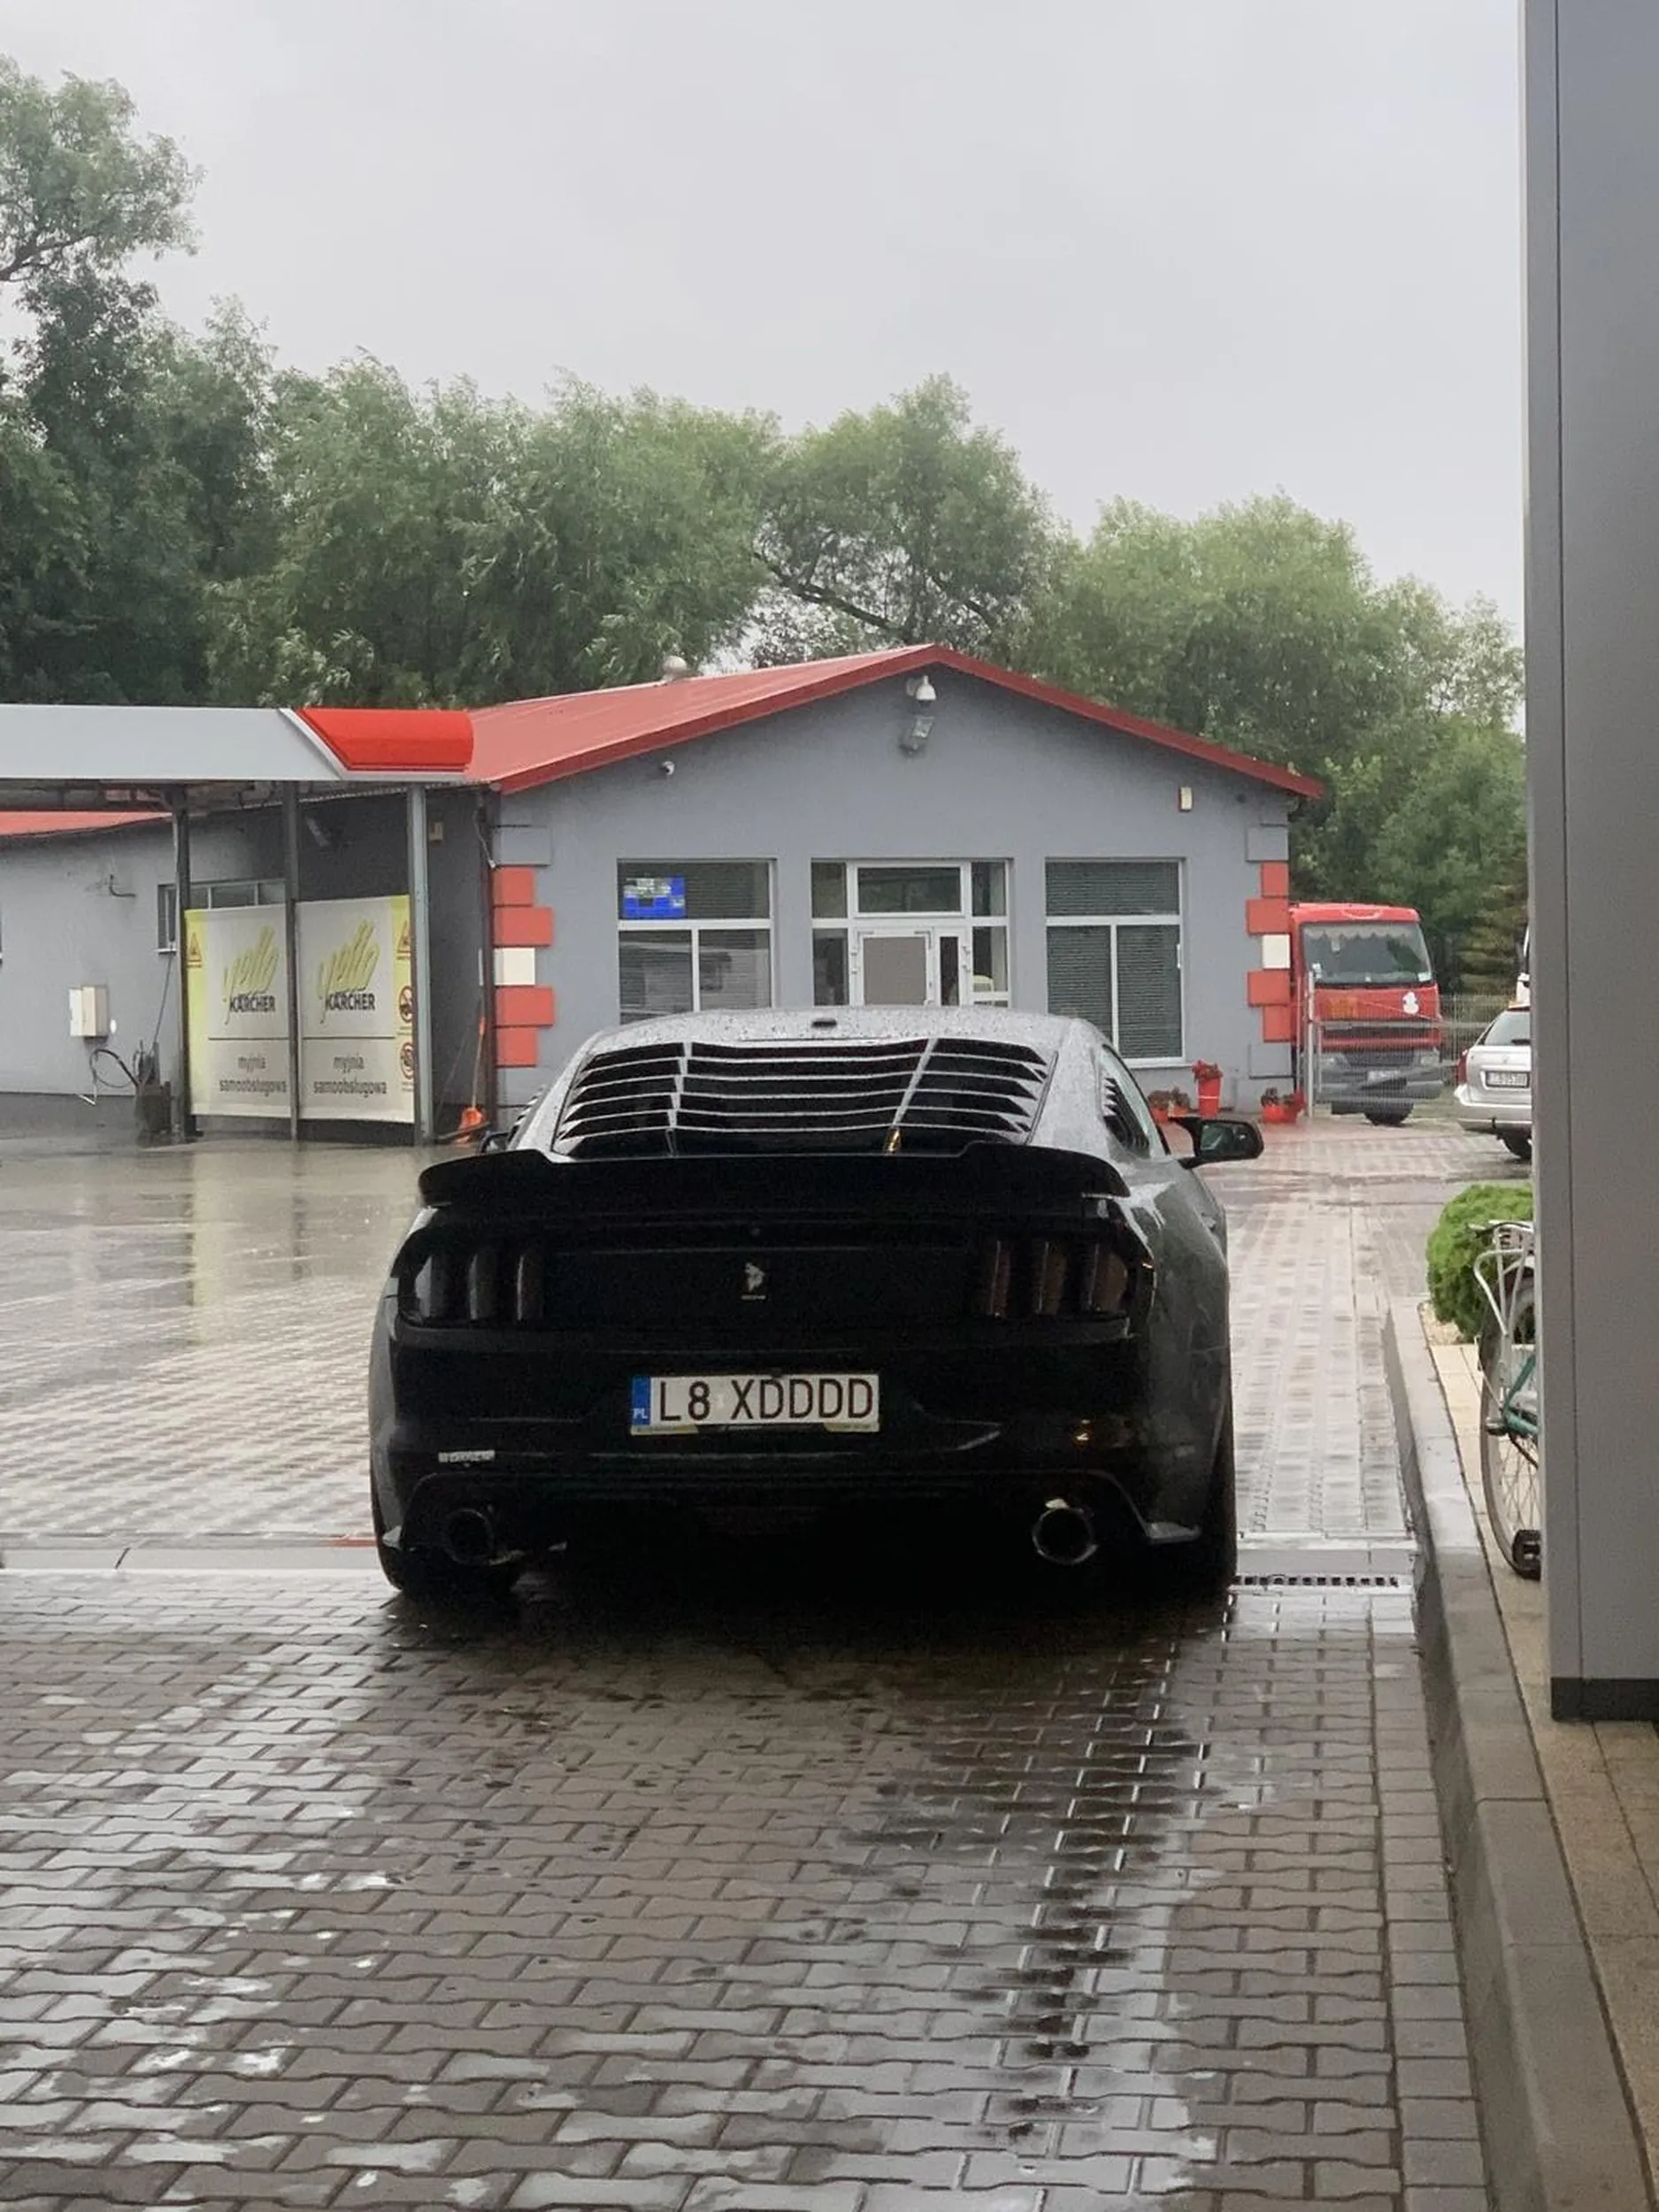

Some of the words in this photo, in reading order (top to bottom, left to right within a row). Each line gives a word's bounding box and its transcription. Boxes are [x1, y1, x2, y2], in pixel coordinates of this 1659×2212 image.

[333, 1051, 365, 1074] myjnia
[659, 1379, 711, 1422] L8
[730, 1377, 874, 1420] XDDDD
[633, 1409, 649, 1419] PL
